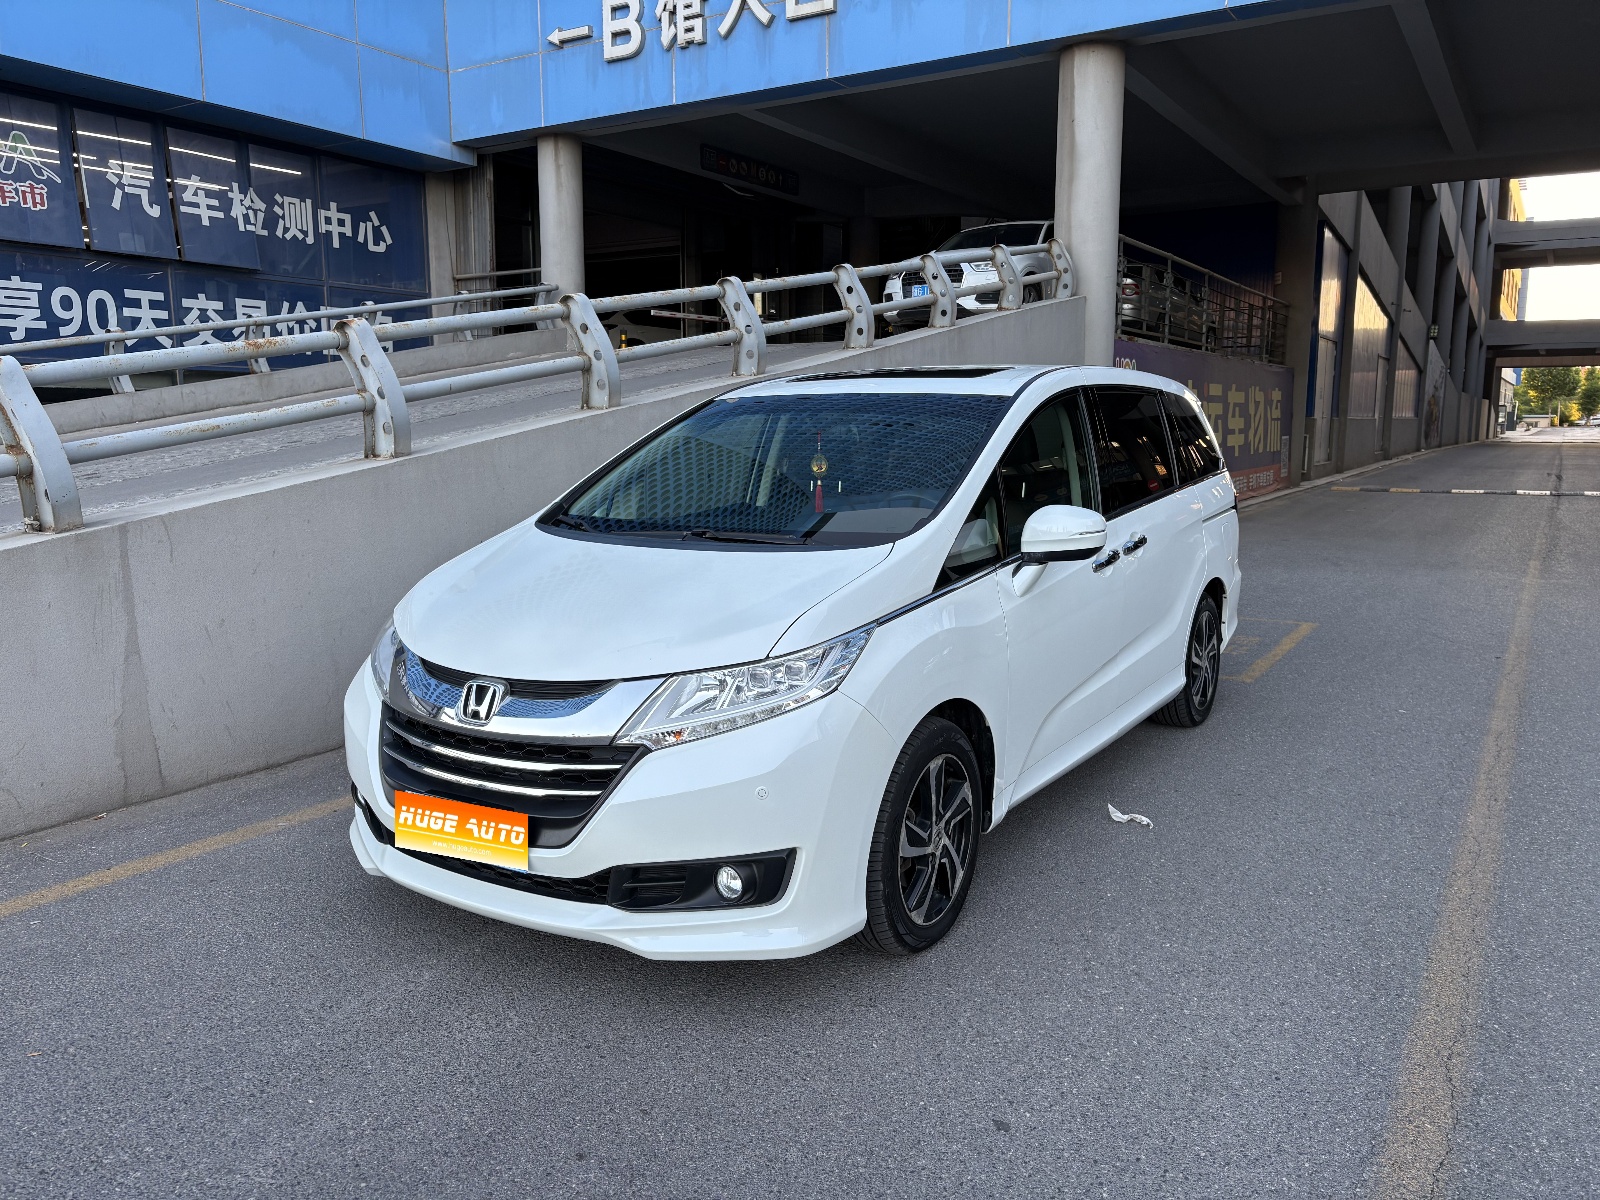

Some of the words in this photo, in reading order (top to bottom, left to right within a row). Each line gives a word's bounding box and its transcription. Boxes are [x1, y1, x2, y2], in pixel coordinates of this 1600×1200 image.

[106, 160, 393, 253] 汽车检测中心
[0, 275, 394, 353] 享90天交易价
[1187, 380, 1282, 457] 运车物流
